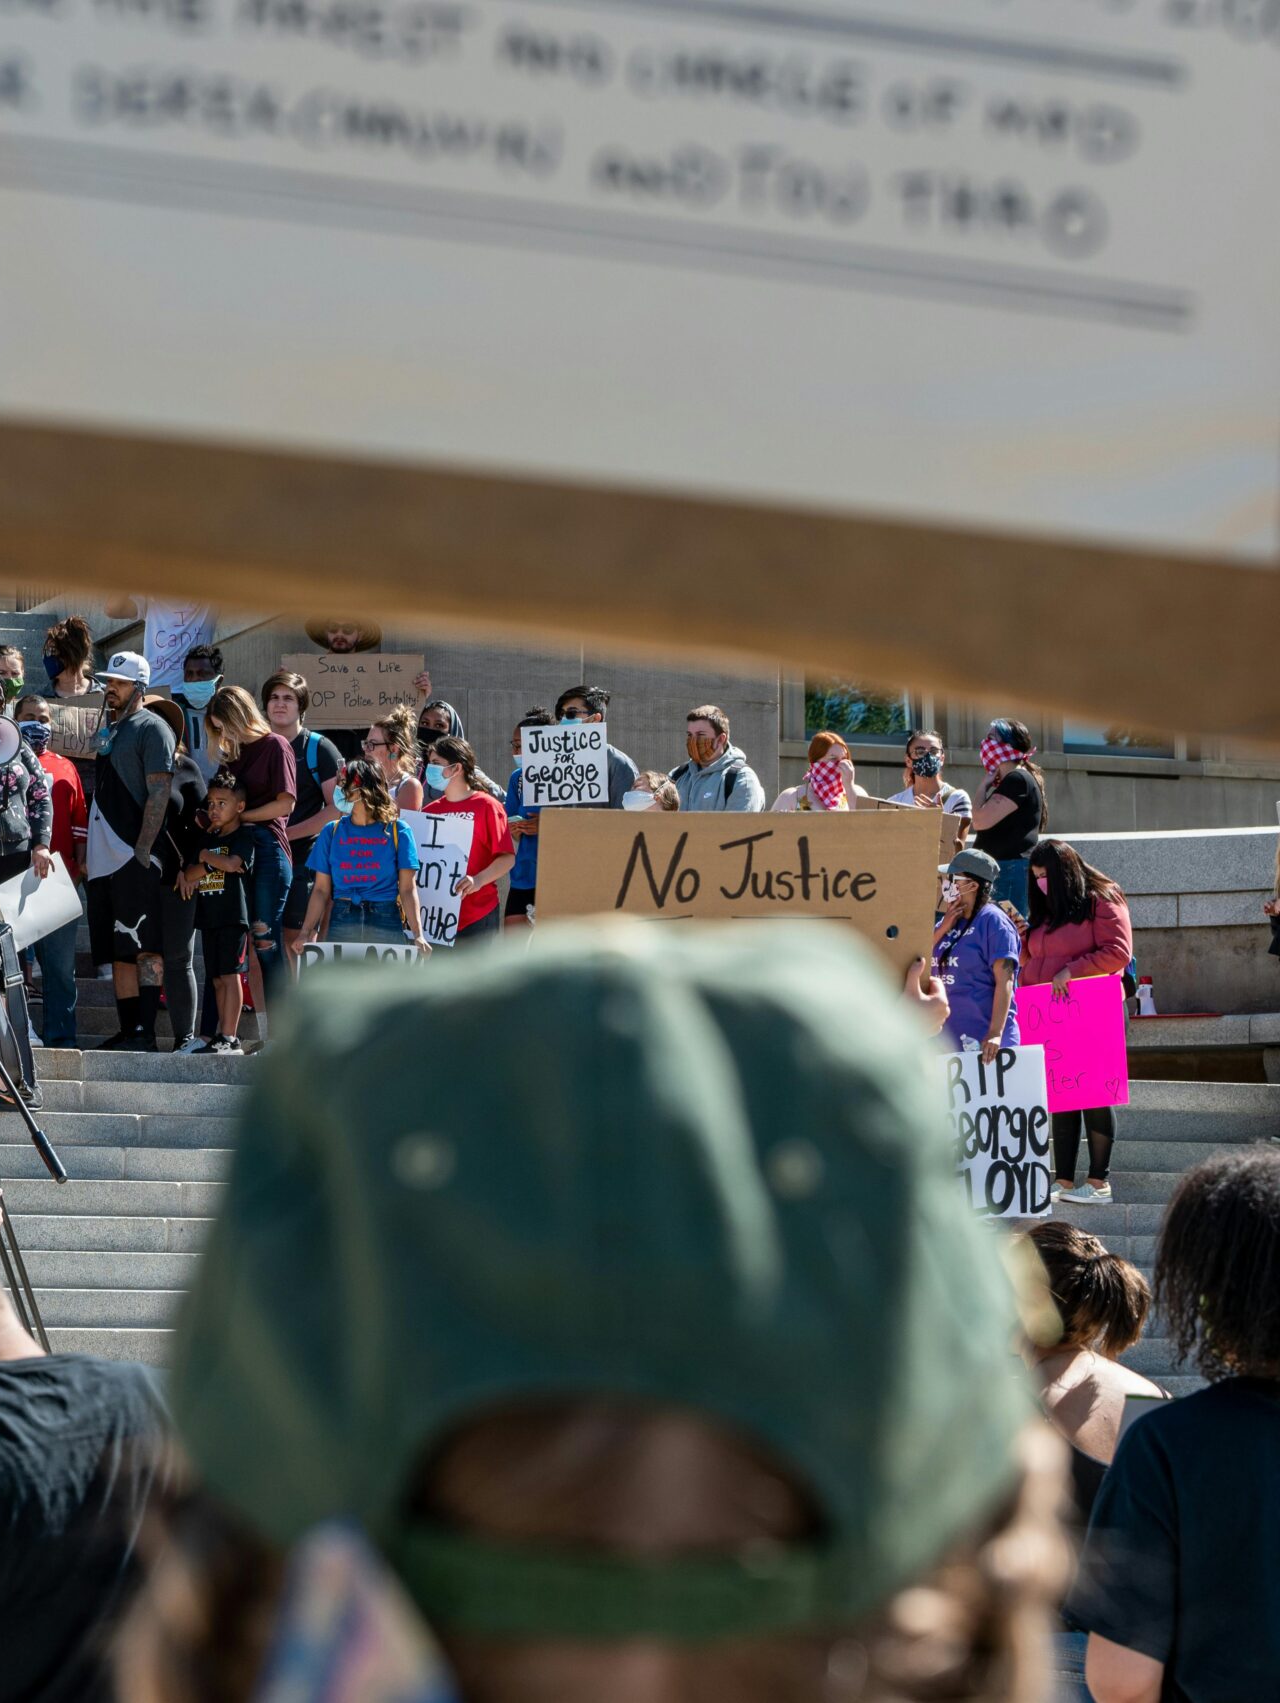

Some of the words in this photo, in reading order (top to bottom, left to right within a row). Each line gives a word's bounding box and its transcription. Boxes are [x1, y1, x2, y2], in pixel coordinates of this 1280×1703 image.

[174, 611, 185, 627] I
[318, 656, 349, 674] Save
[356, 664, 367, 673] a
[378, 660, 403, 673] Life
[309, 691, 336, 707] OP
[343, 692, 374, 707] Police
[528, 730, 601, 753] Justice
[534, 782, 601, 803] FLOYD
[421, 815, 445, 849] I
[339, 837, 388, 847] LATINOS
[339, 862, 381, 871] BLACK
[615, 831, 700, 909] No
[719, 830, 877, 901] Justice
[343, 875, 378, 884] LIVES
[947, 1047, 1017, 1109] RIP
[1047, 1068, 1087, 1094] ter
